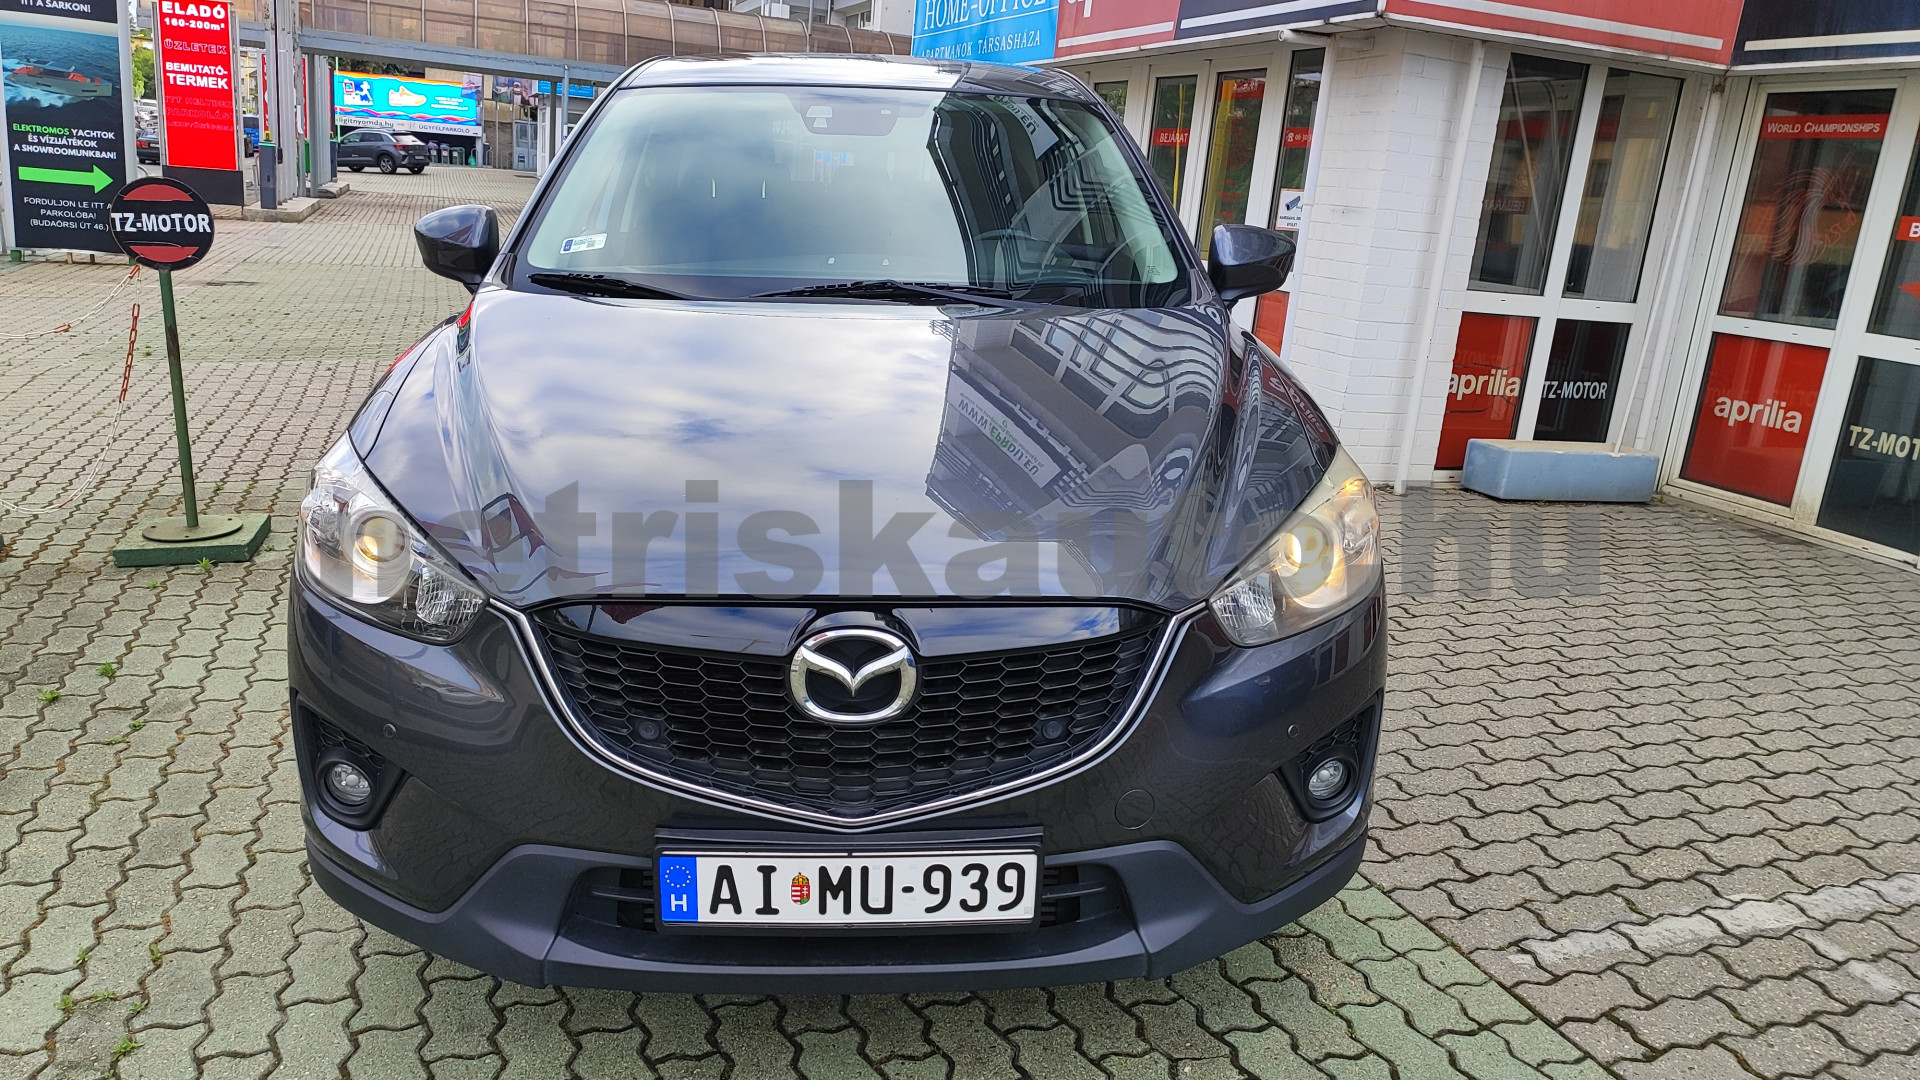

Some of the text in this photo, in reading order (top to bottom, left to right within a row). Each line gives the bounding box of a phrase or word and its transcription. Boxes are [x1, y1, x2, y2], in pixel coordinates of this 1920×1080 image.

[45, 0, 91, 13] SARKON!
[162, 1, 225, 19] ELADÓ
[923, 0, 1046, 30] HOME-O
[977, 29, 1041, 54] TÁRSASHÁZA
[165, 62, 228, 76] BEMUTATÓ-
[166, 73, 229, 89] TERMEK
[12, 123, 115, 139] ELEKTROMOS YACHTOK
[28, 133, 38, 143] ÉS
[1160, 130, 1188, 143] BEJÁRAT
[22, 144, 117, 159] SHOWROOMUNKBAN!
[24, 197, 76, 208] FORDULJON
[40, 209, 97, 219] PARKOLÓBA!
[111, 212, 211, 232] TZ-MOTOR
[1448, 369, 1522, 400] aprilia
[1543, 381, 1608, 399] TZ-MOTOR
[1714, 396, 1802, 434] aprilia
[1849, 424, 1920, 461] TZ-MOT
[709, 862, 1026, 915] AI MU-939
[670, 893, 688, 912] H
